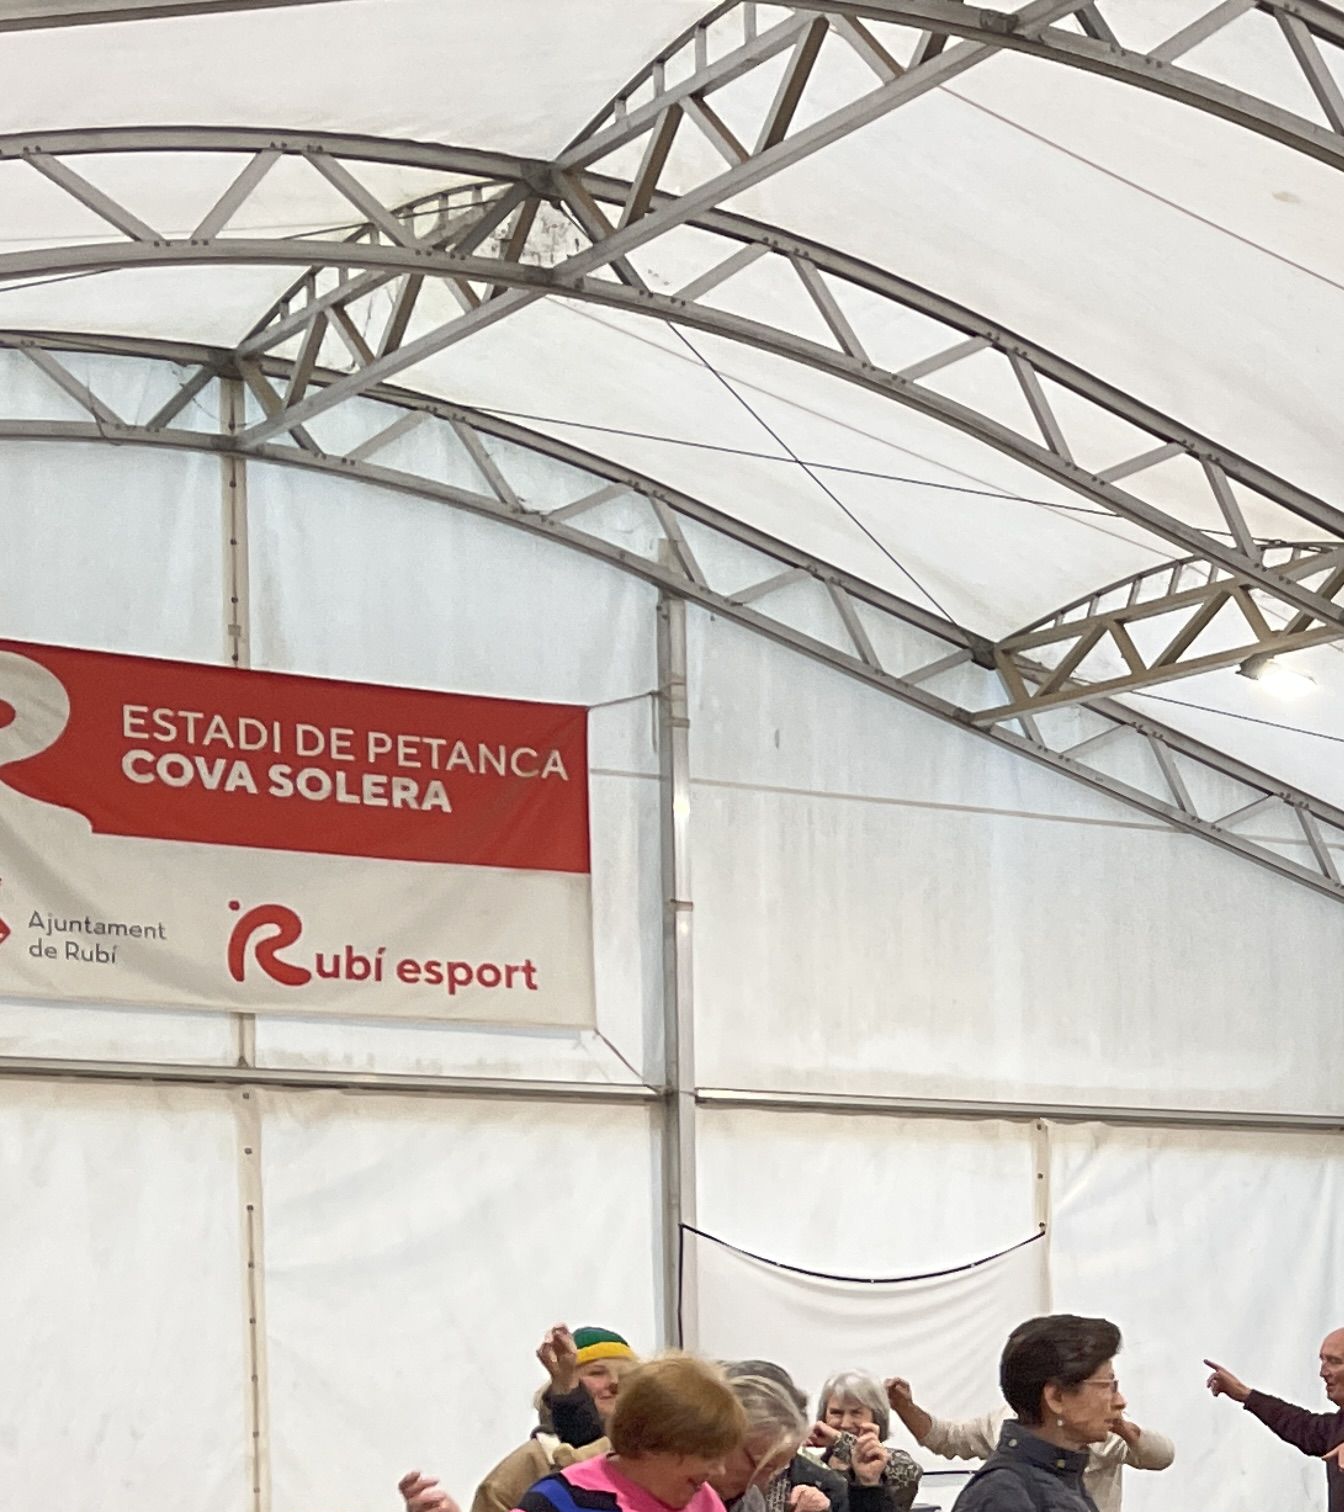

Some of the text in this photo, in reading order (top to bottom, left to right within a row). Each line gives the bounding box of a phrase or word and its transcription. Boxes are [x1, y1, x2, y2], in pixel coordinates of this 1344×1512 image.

[122, 704, 569, 781] ESTADI DE PETANCA
[121, 749, 452, 813] COVA SOLERA
[28, 910, 167, 940] Ajuntament
[28, 937, 118, 964] de Rubí
[227, 900, 538, 996] Rubí esport
